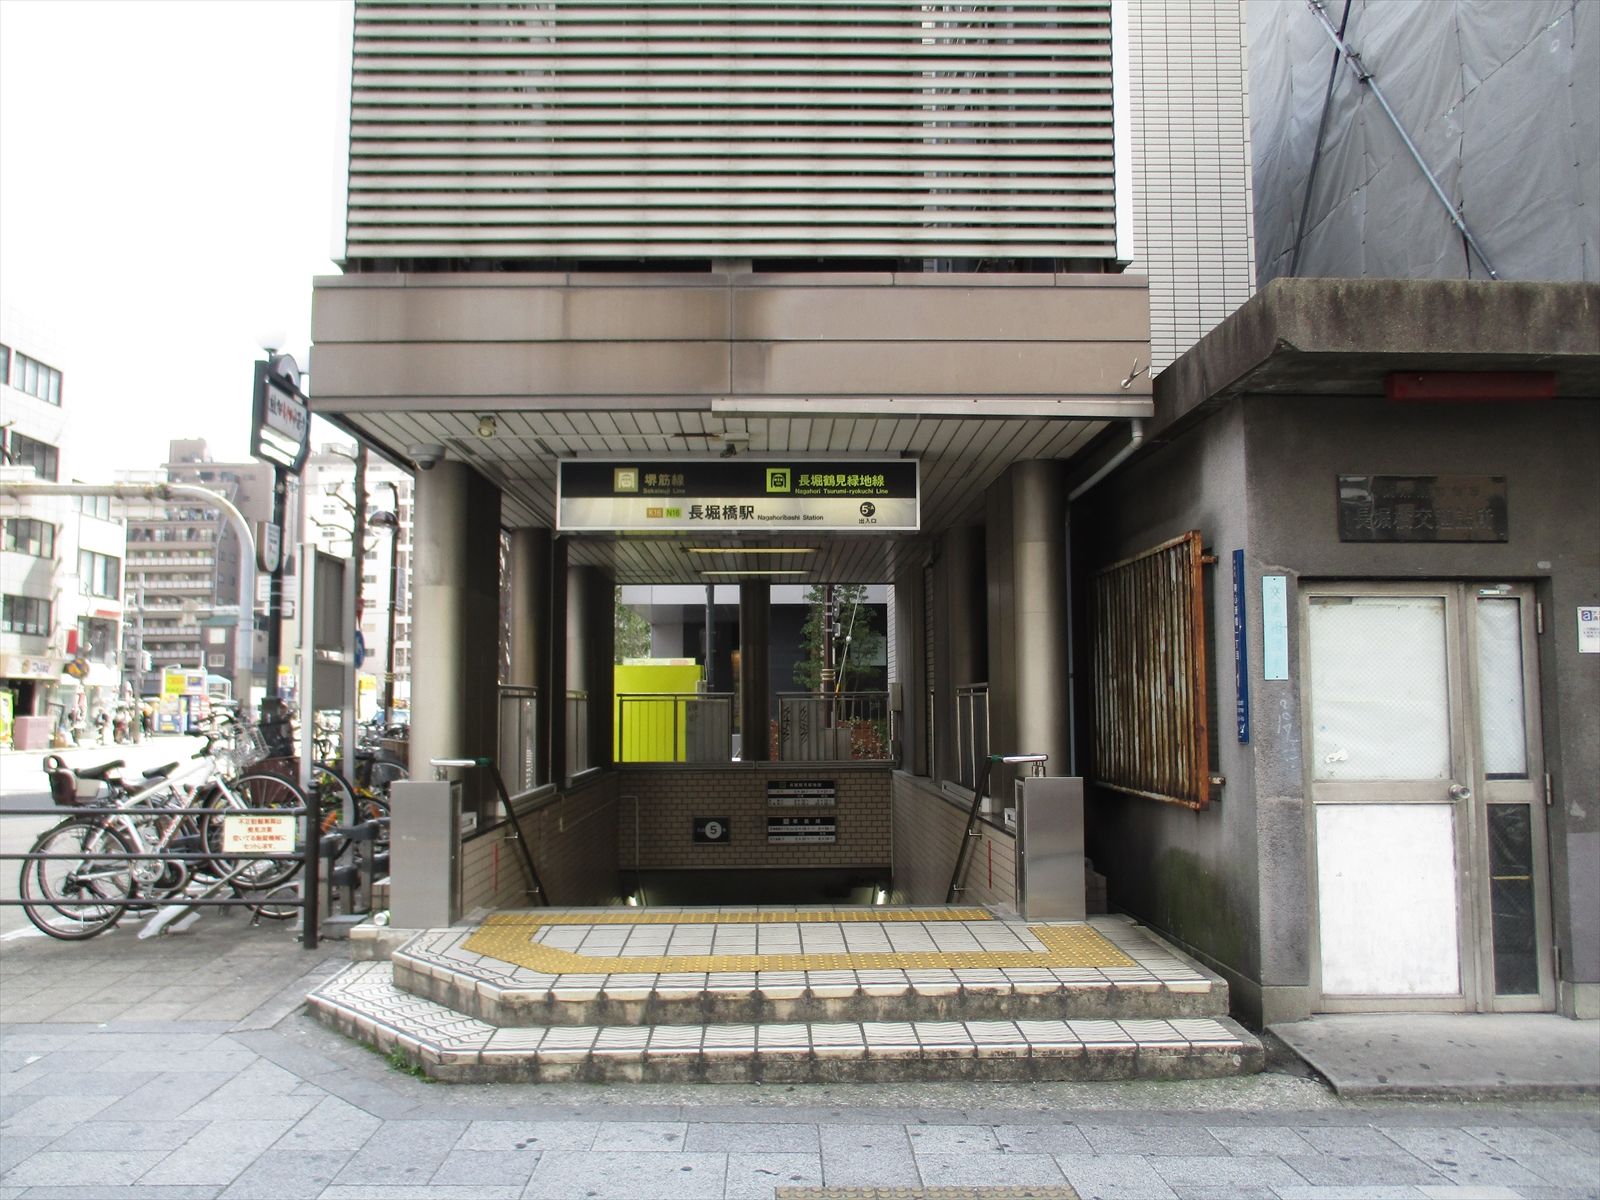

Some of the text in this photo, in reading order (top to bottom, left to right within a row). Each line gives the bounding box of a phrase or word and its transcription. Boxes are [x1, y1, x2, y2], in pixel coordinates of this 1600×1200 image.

[644, 473, 685, 487] 堺筋線
[798, 474, 885, 487] 長堀鶴見緑地線
[794, 488, 821, 496] Nagahori
[666, 508, 681, 517] N16
[688, 504, 755, 521] 長堀橋駅
[757, 514, 800, 522] Nagahoribashi
